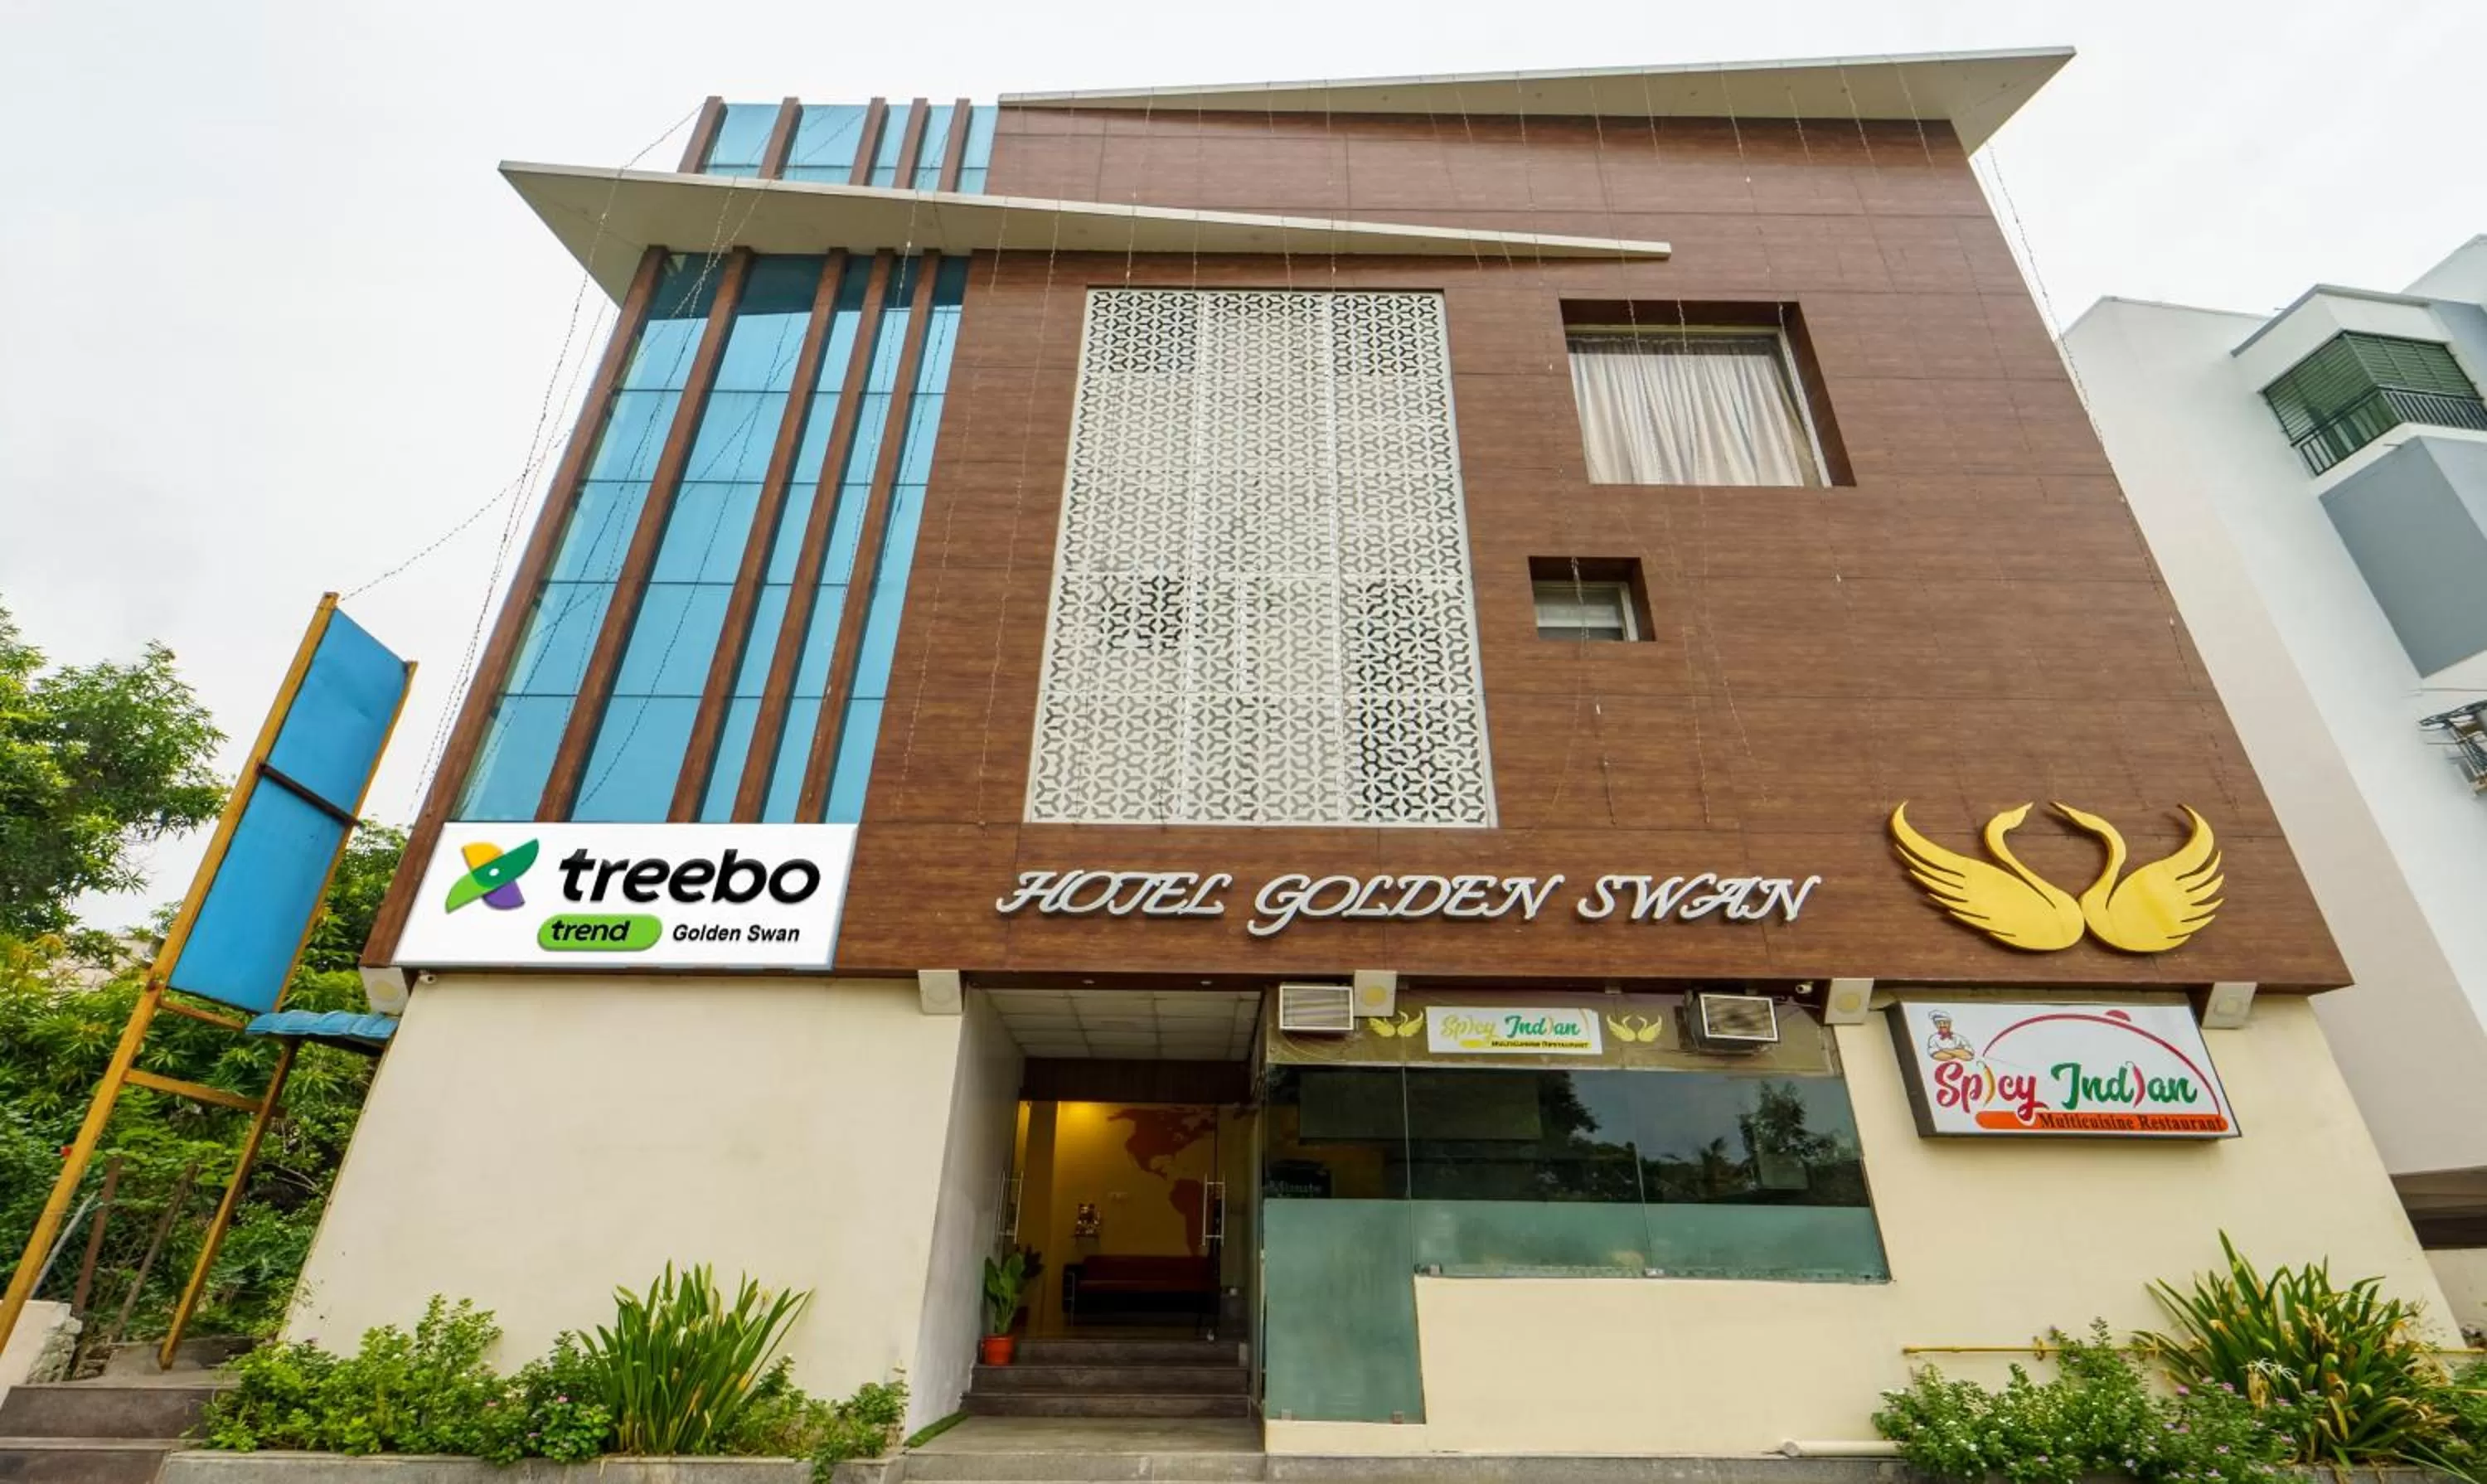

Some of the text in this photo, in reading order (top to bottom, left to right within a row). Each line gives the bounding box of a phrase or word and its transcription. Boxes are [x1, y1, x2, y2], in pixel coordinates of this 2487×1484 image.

[558, 848, 822, 904] treebo
[996, 870, 1821, 936] HOTEL GOLDEN SWAN
[551, 919, 631, 943] trend
[672, 925, 801, 943] Golden Swan
[1934, 1060, 2198, 1122] Spicy Indian
[2039, 1113, 2224, 1132] Multicuisine Restaurant
